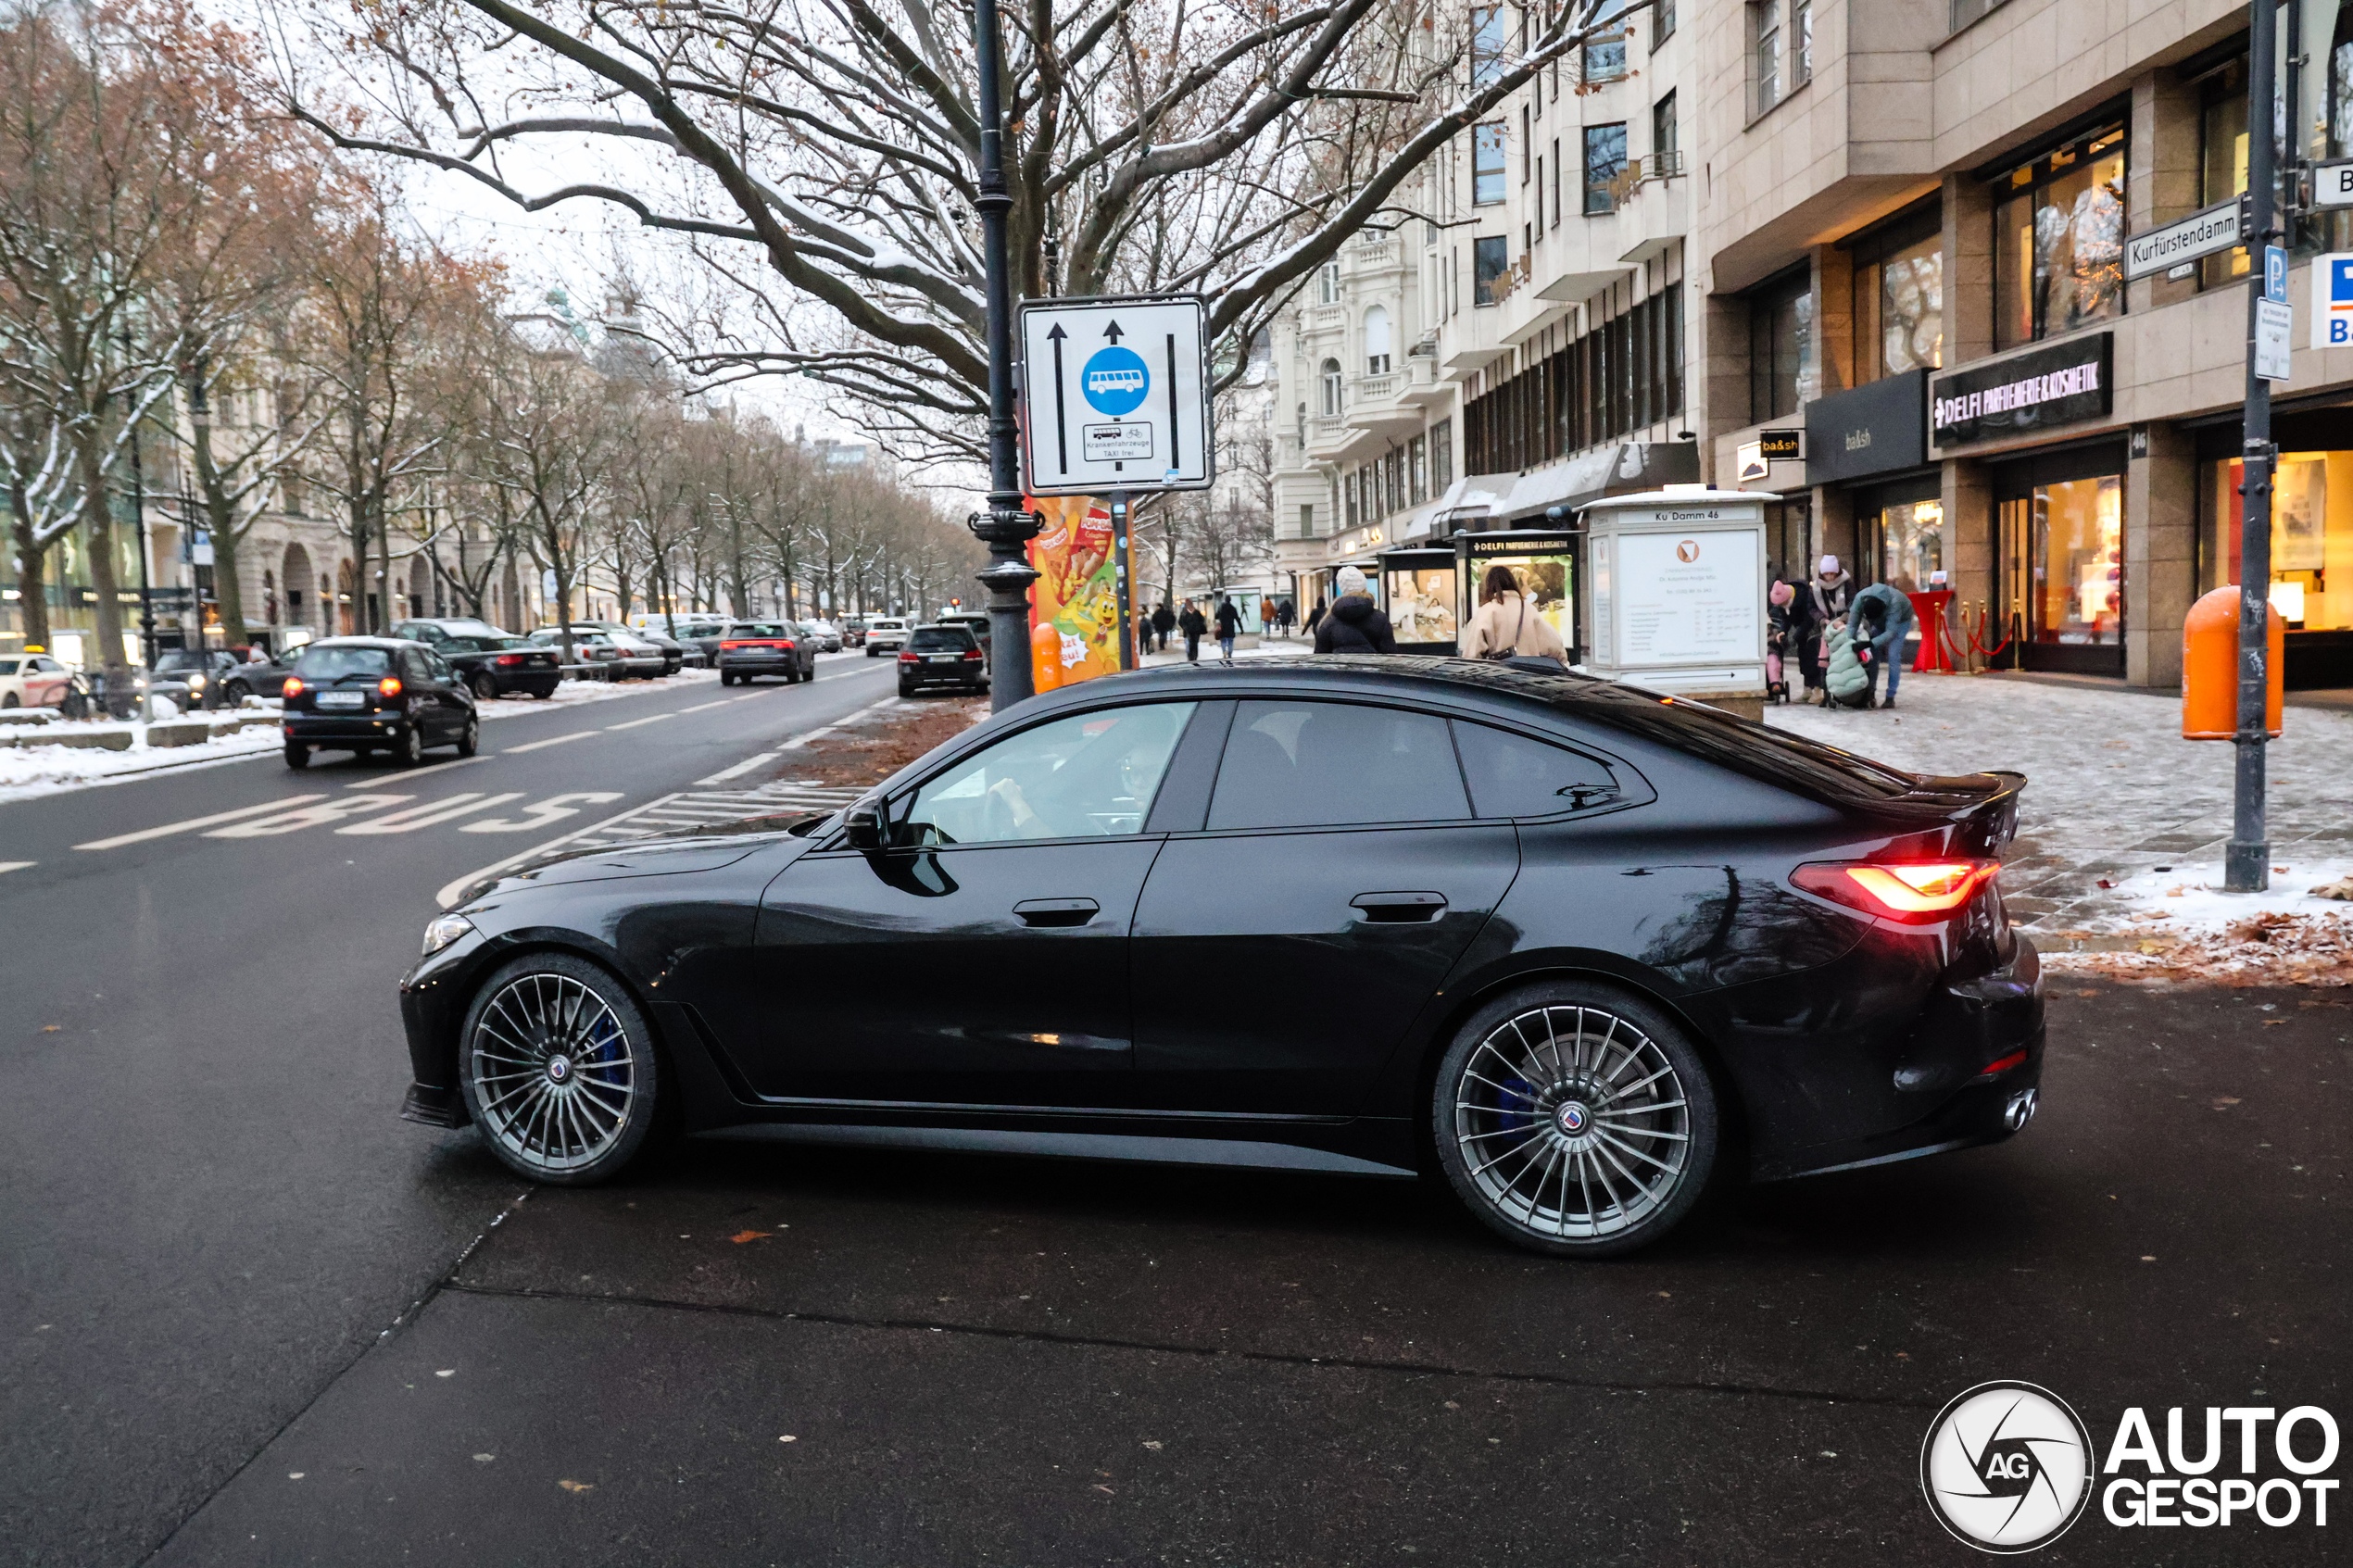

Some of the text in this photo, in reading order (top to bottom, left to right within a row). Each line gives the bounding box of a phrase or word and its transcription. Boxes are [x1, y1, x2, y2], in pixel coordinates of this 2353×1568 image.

[2133, 217, 2234, 265] Kurfürstendamm
[2331, 320, 2353, 343] B
[1944, 392, 1982, 424] DELFI
[1087, 440, 1150, 448] Krankenfahrzeuge
[1762, 439, 1798, 452] ba&sh
[1845, 428, 1871, 451] ba&sh
[2133, 433, 2145, 449] 46
[1707, 510, 1719, 519] 46
[1480, 542, 1504, 551] DELFI
[1061, 649, 1079, 661] eu!
[201, 792, 625, 838] BUS
